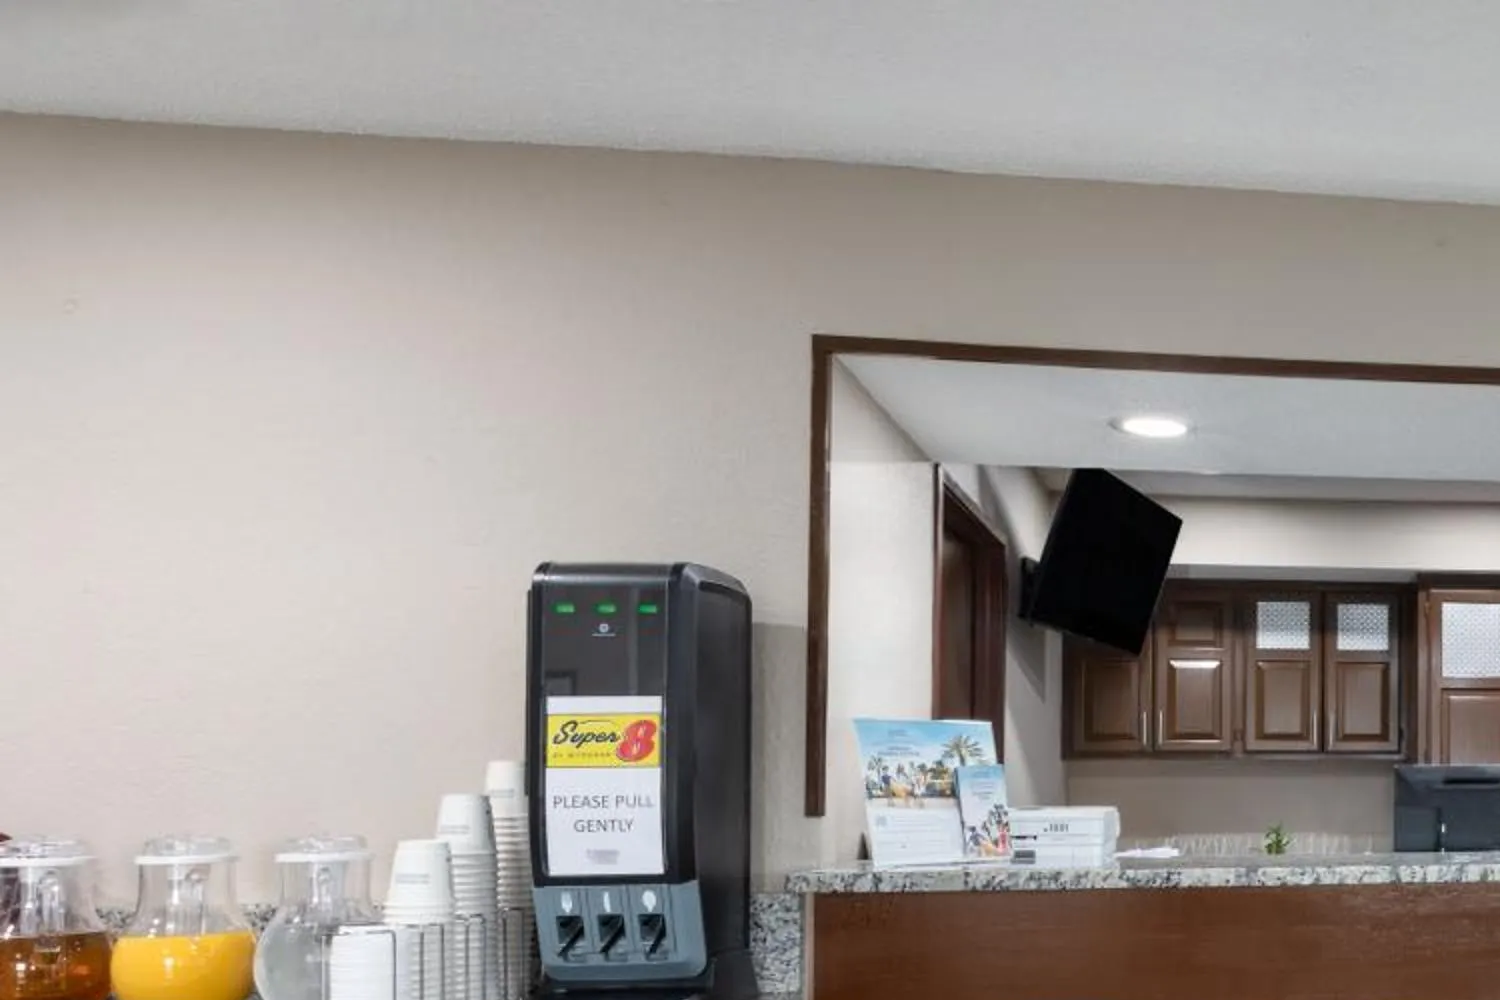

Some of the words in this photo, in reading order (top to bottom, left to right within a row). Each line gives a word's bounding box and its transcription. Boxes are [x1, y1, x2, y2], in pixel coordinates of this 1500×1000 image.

[552, 719, 619, 749] Super
[616, 719, 658, 762] 8
[553, 794, 609, 809] PLEASE
[615, 794, 655, 808] PULL
[573, 818, 634, 833] GENTLY
